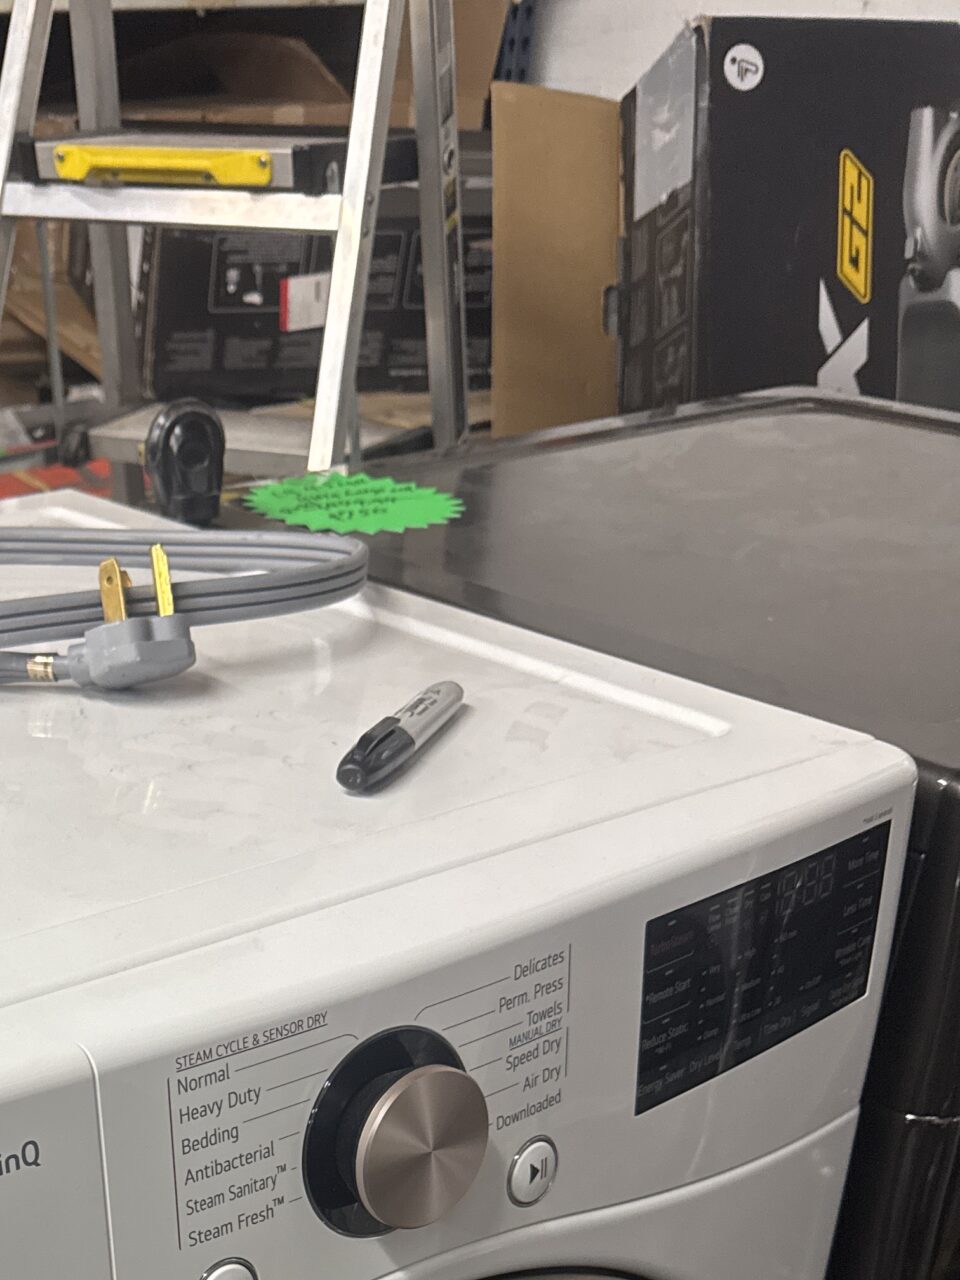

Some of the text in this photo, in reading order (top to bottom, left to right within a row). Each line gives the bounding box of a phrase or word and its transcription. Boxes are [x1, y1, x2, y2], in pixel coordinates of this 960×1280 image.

[513, 950, 565, 981] Delicates
[498, 976, 564, 1014] Perm. Press
[526, 1000, 563, 1027] Towels
[175, 1011, 328, 1070] STEAM CYCLE & SENSOR DRY
[508, 1015, 563, 1050] MANUAL DRY
[505, 1035, 562, 1073] Speed Dry
[177, 1063, 230, 1095] Normal
[522, 1064, 562, 1093] Air Dry
[179, 1086, 262, 1124] Heavy Duty
[496, 1088, 562, 1131] Downloaded
[181, 1125, 239, 1155] Bedding
[184, 1140, 275, 1186] Antibacterial
[186, 1192, 225, 1216] Steam
[188, 1221, 233, 1247] Steam
